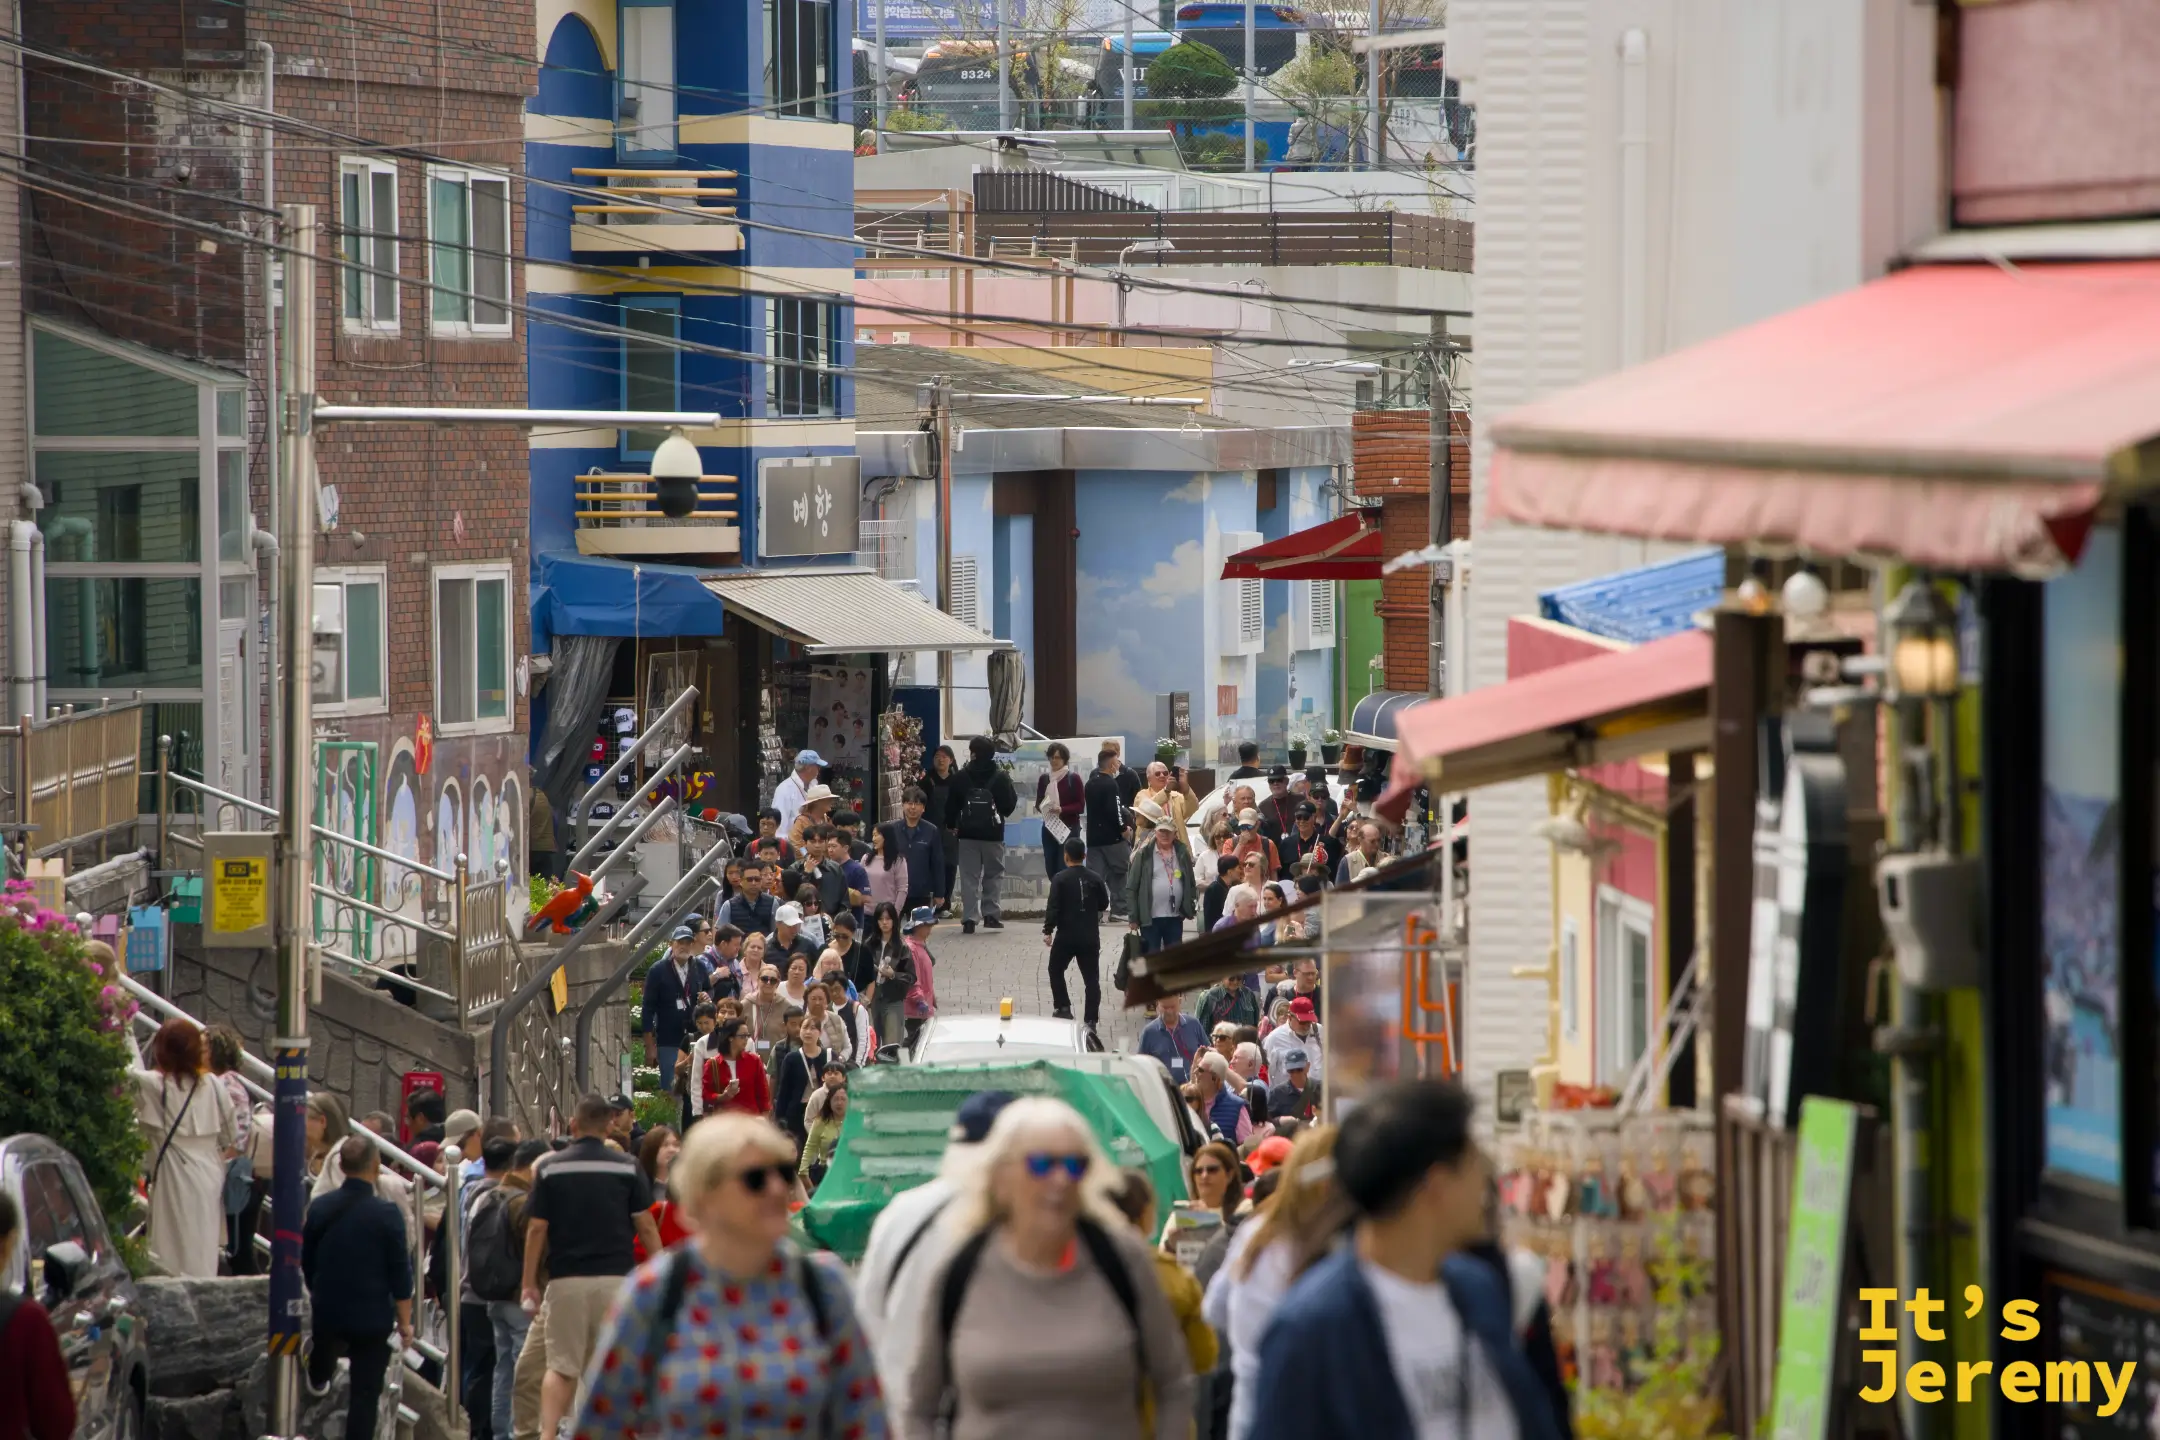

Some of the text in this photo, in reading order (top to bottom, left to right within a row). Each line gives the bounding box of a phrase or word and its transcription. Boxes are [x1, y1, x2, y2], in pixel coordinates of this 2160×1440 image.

[867, 5, 955, 19] 평학습프로그램
[960, 69, 992, 80] 8324
[793, 484, 832, 537] 예향
